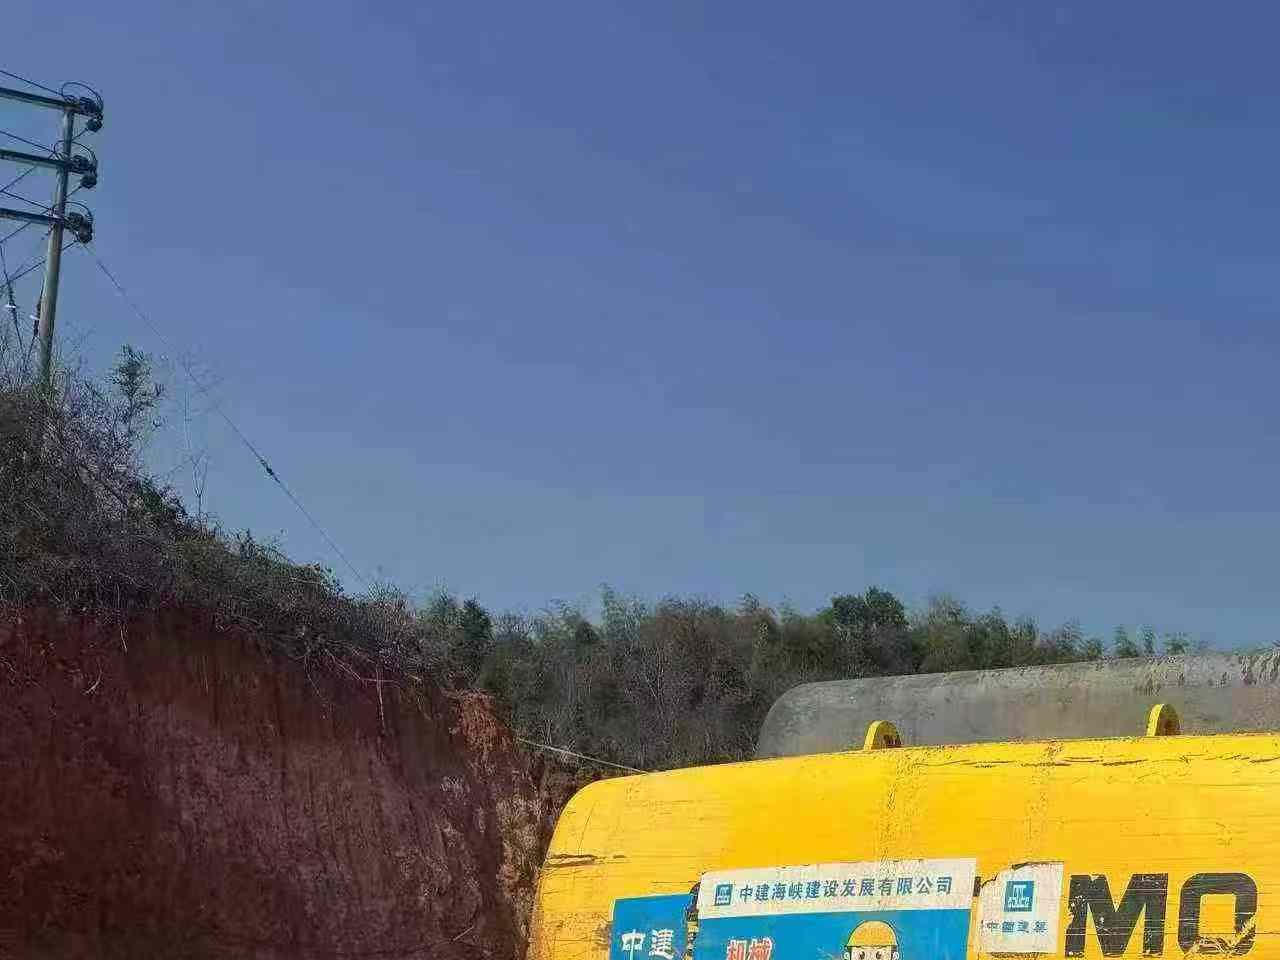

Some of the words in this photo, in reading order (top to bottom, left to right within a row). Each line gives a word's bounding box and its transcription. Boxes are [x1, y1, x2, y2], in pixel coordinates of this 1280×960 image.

[739, 876, 953, 902] 中建海峡建设发展有限公司
